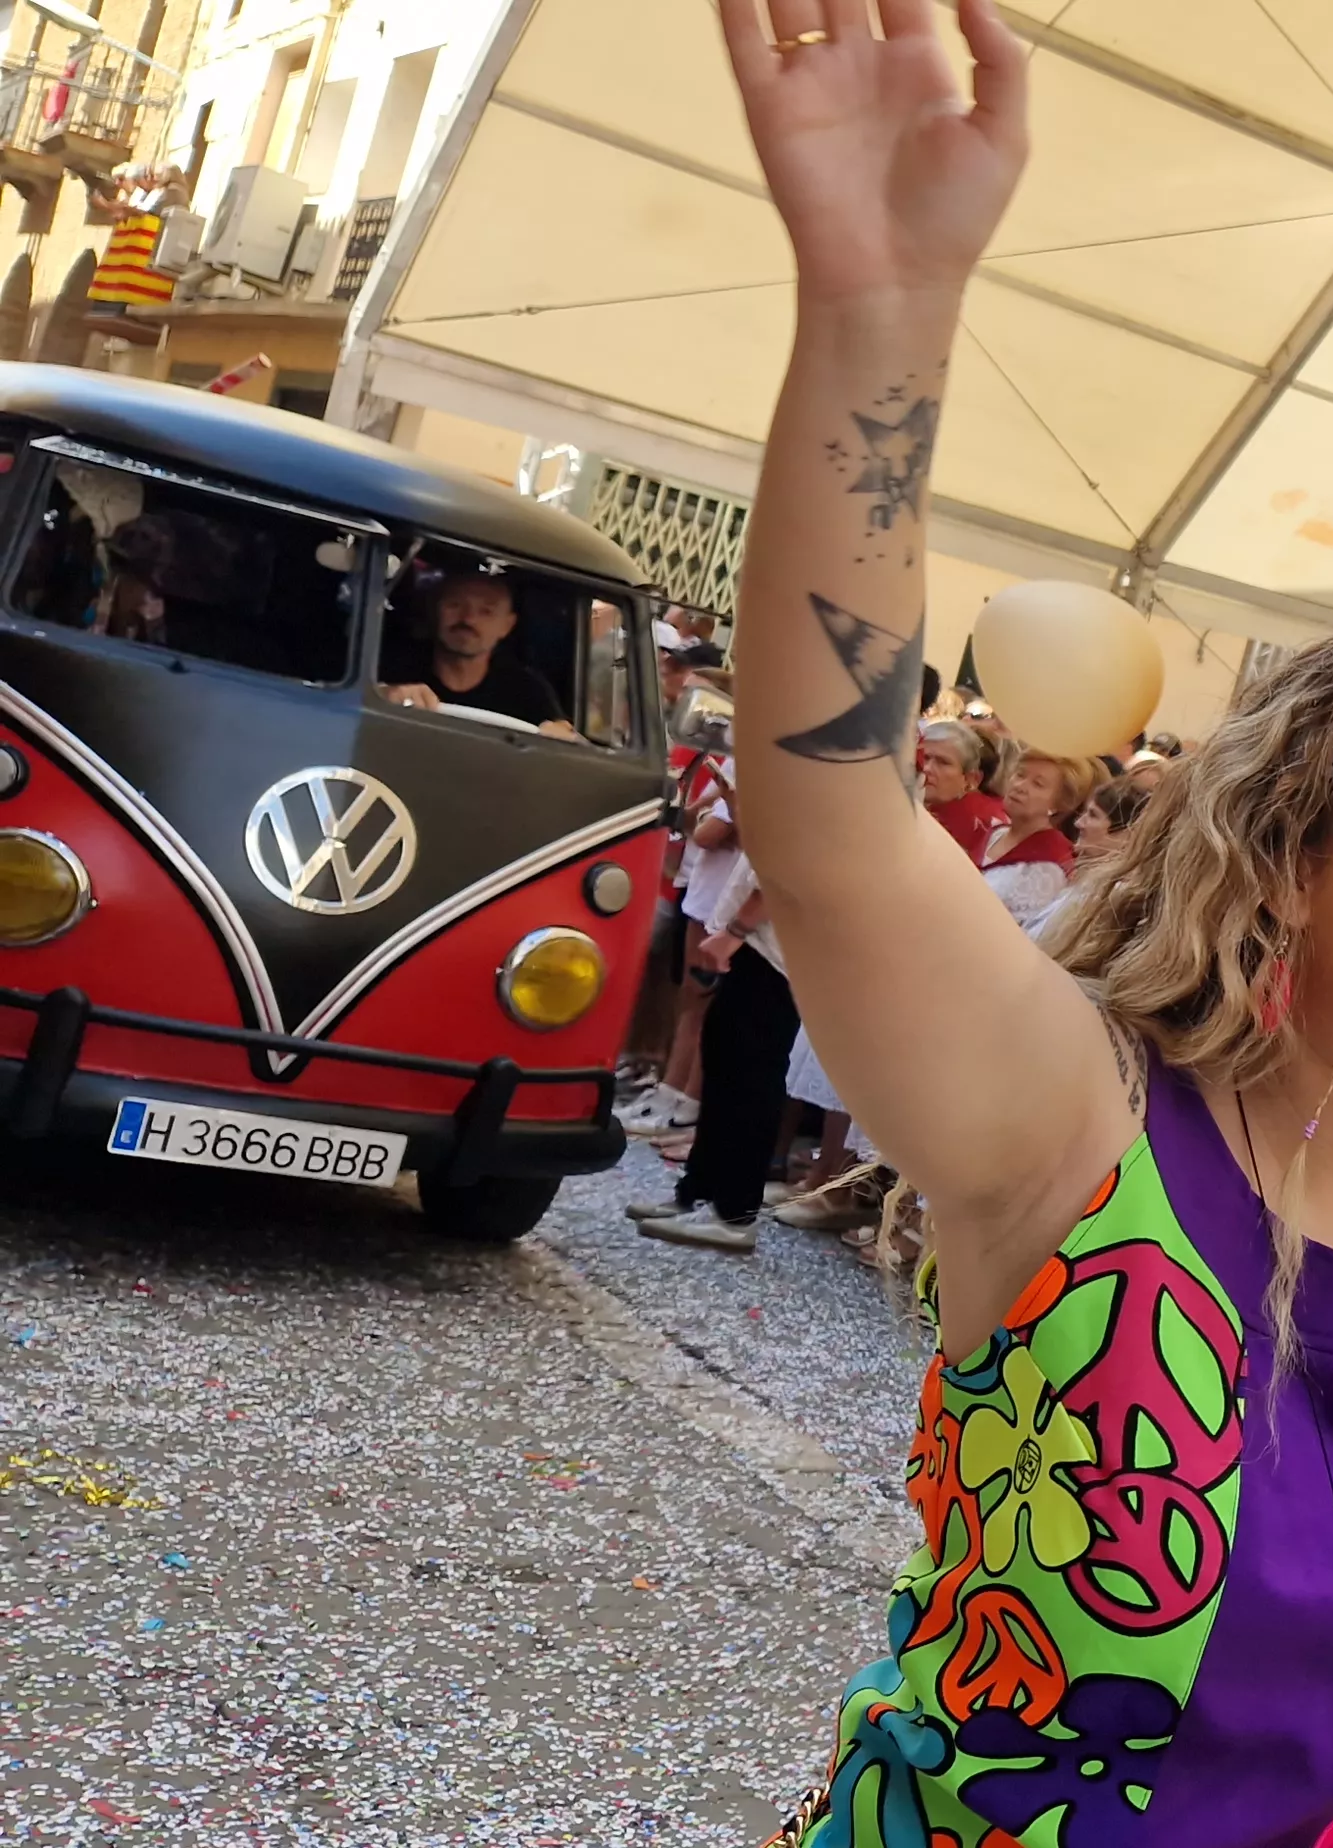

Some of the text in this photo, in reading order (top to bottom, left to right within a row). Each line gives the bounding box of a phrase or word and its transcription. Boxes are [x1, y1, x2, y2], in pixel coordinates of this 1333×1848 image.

[140, 1112, 389, 1181] H 3666 BBB
